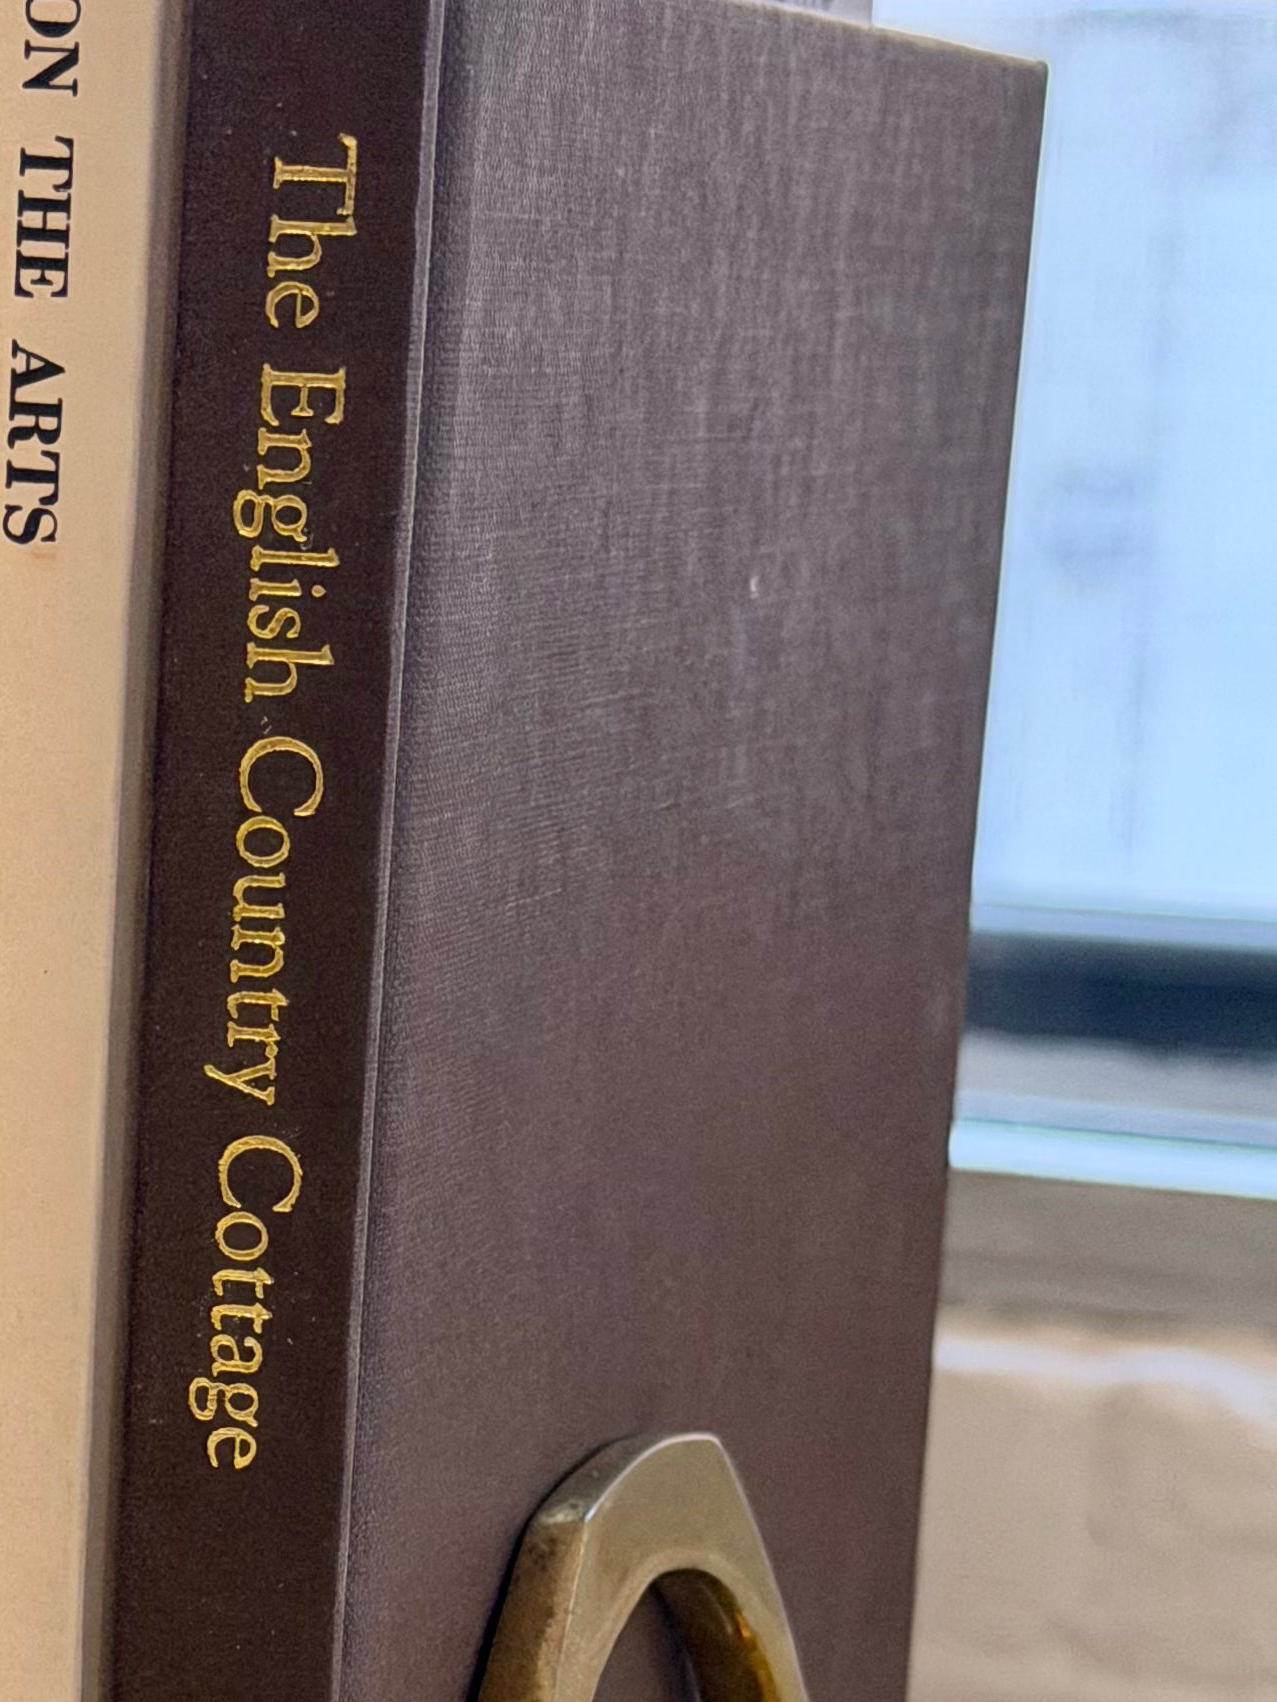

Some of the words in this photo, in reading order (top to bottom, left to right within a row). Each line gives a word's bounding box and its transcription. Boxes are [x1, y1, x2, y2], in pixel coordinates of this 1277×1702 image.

[13, 135, 75, 299] THE
[264, 132, 358, 329] The
[2, 338, 66, 546] ARTS
[232, 362, 347, 703] English
[204, 735, 324, 1105] Country
[188, 1135, 303, 1469] Cottage
